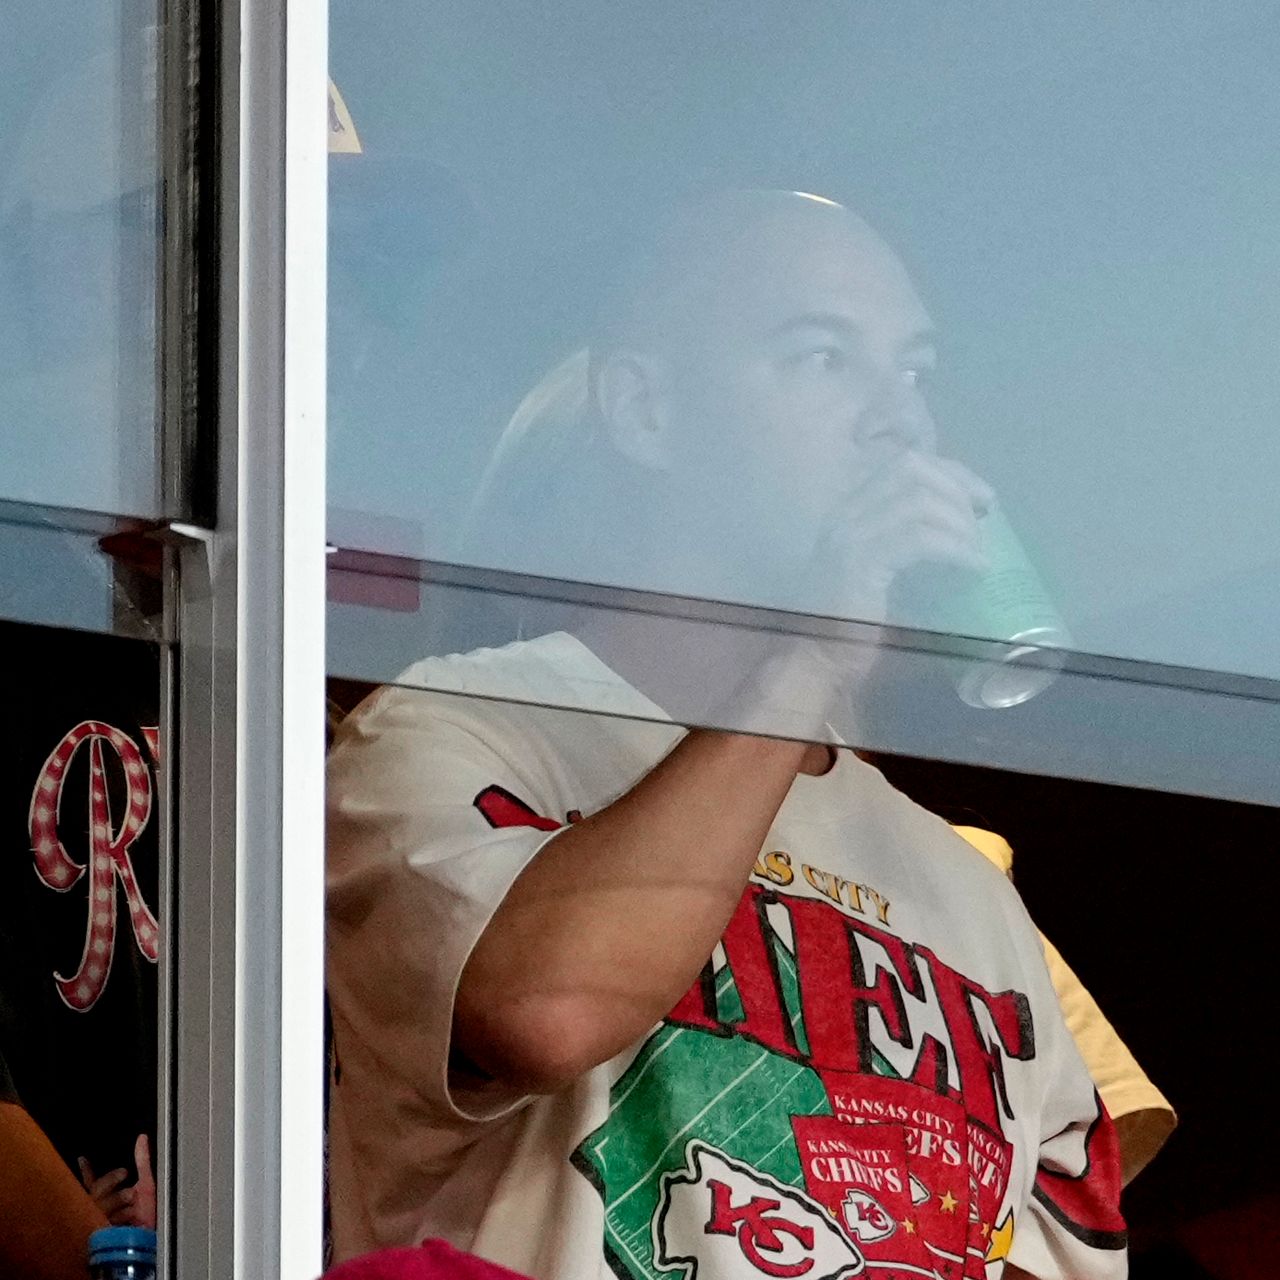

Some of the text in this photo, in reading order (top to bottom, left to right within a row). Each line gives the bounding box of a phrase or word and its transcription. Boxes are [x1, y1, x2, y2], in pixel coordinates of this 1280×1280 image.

[28, 720, 158, 1012] R
[802, 863, 890, 927] CITY
[833, 1094, 956, 1135] KANSAS CITY
[705, 1178, 815, 1278] KC
